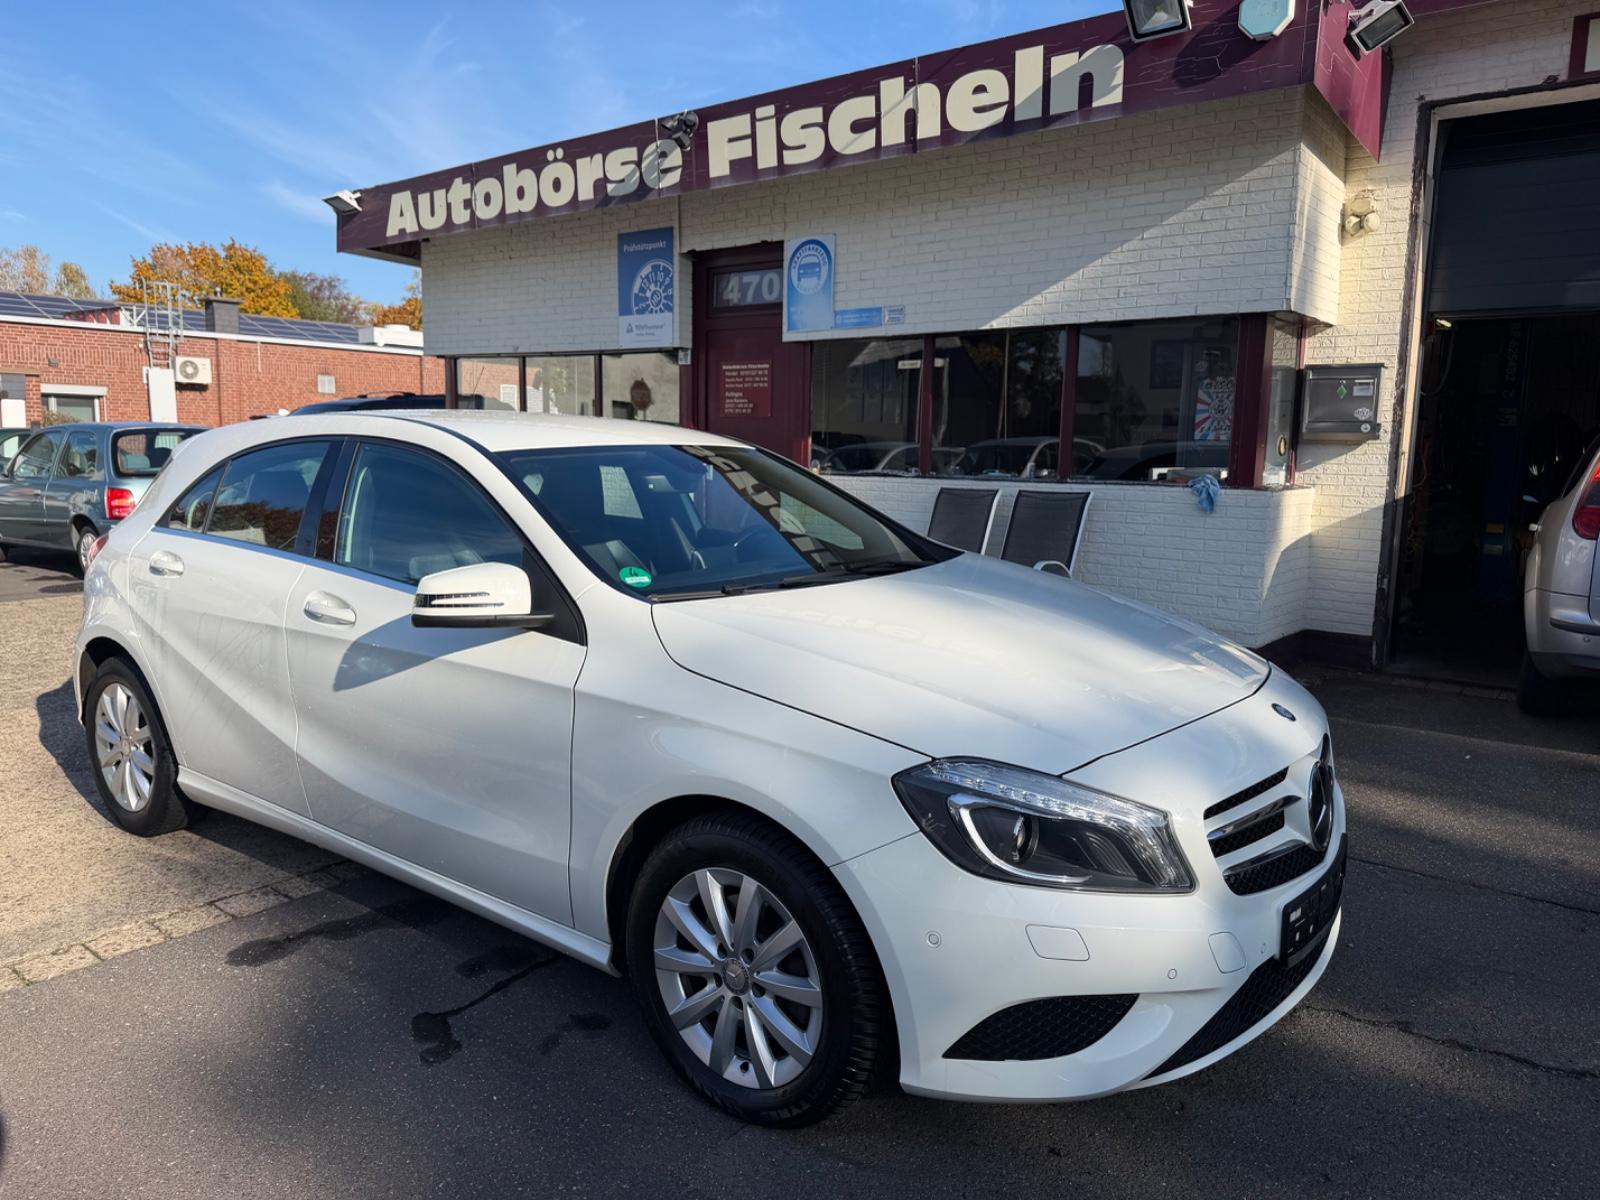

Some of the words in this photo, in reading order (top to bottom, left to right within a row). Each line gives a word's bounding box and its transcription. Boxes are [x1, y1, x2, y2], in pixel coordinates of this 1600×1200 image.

[384, 136, 684, 237] Autobörse
[706, 43, 1124, 178] Fischeln
[722, 272, 780, 303] 470
